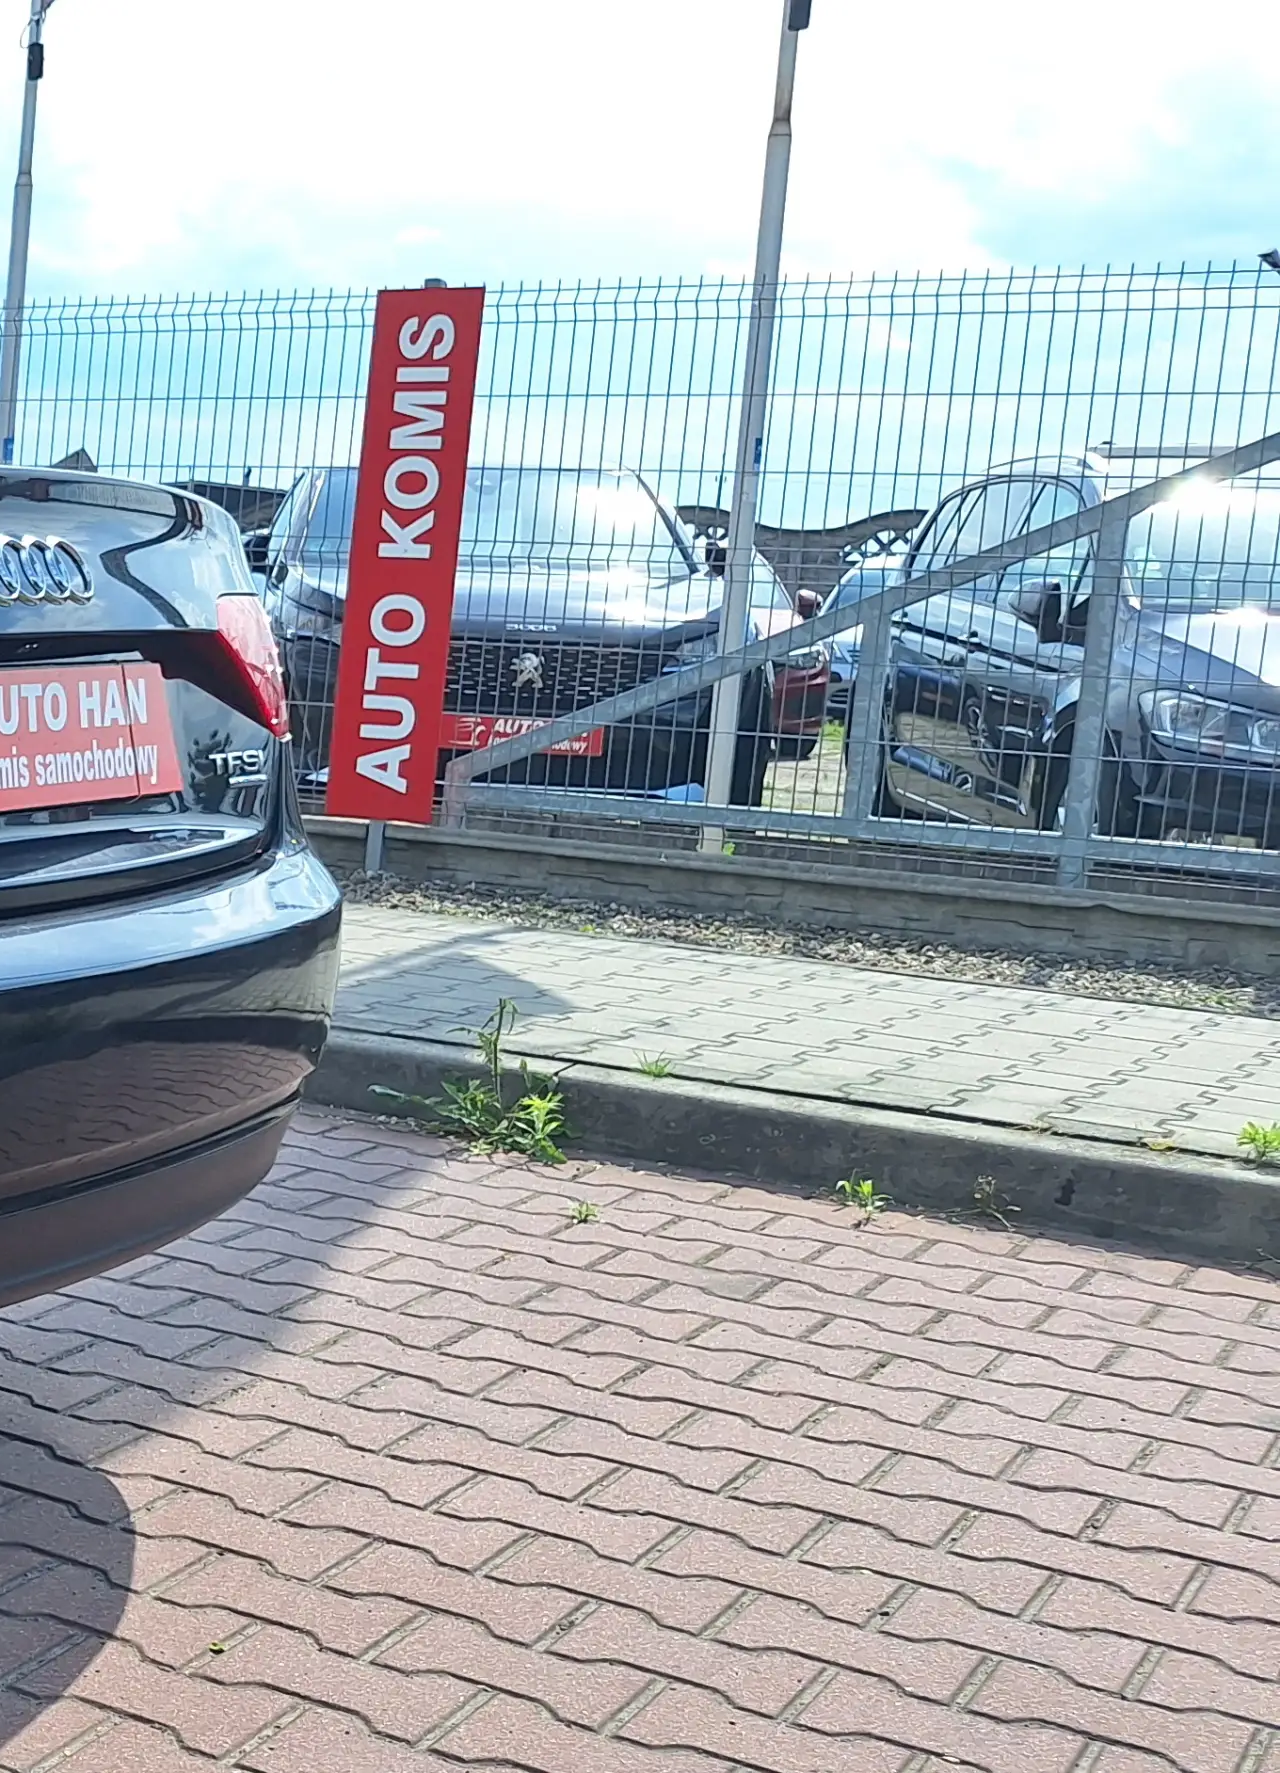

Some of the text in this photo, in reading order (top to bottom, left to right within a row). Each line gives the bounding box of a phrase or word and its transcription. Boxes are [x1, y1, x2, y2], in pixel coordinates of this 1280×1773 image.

[355, 312, 456, 795] AUTO KOMIS
[78, 677, 148, 729] HAN
[34, 739, 158, 785] samochodowy
[208, 749, 265, 775] TFSI
